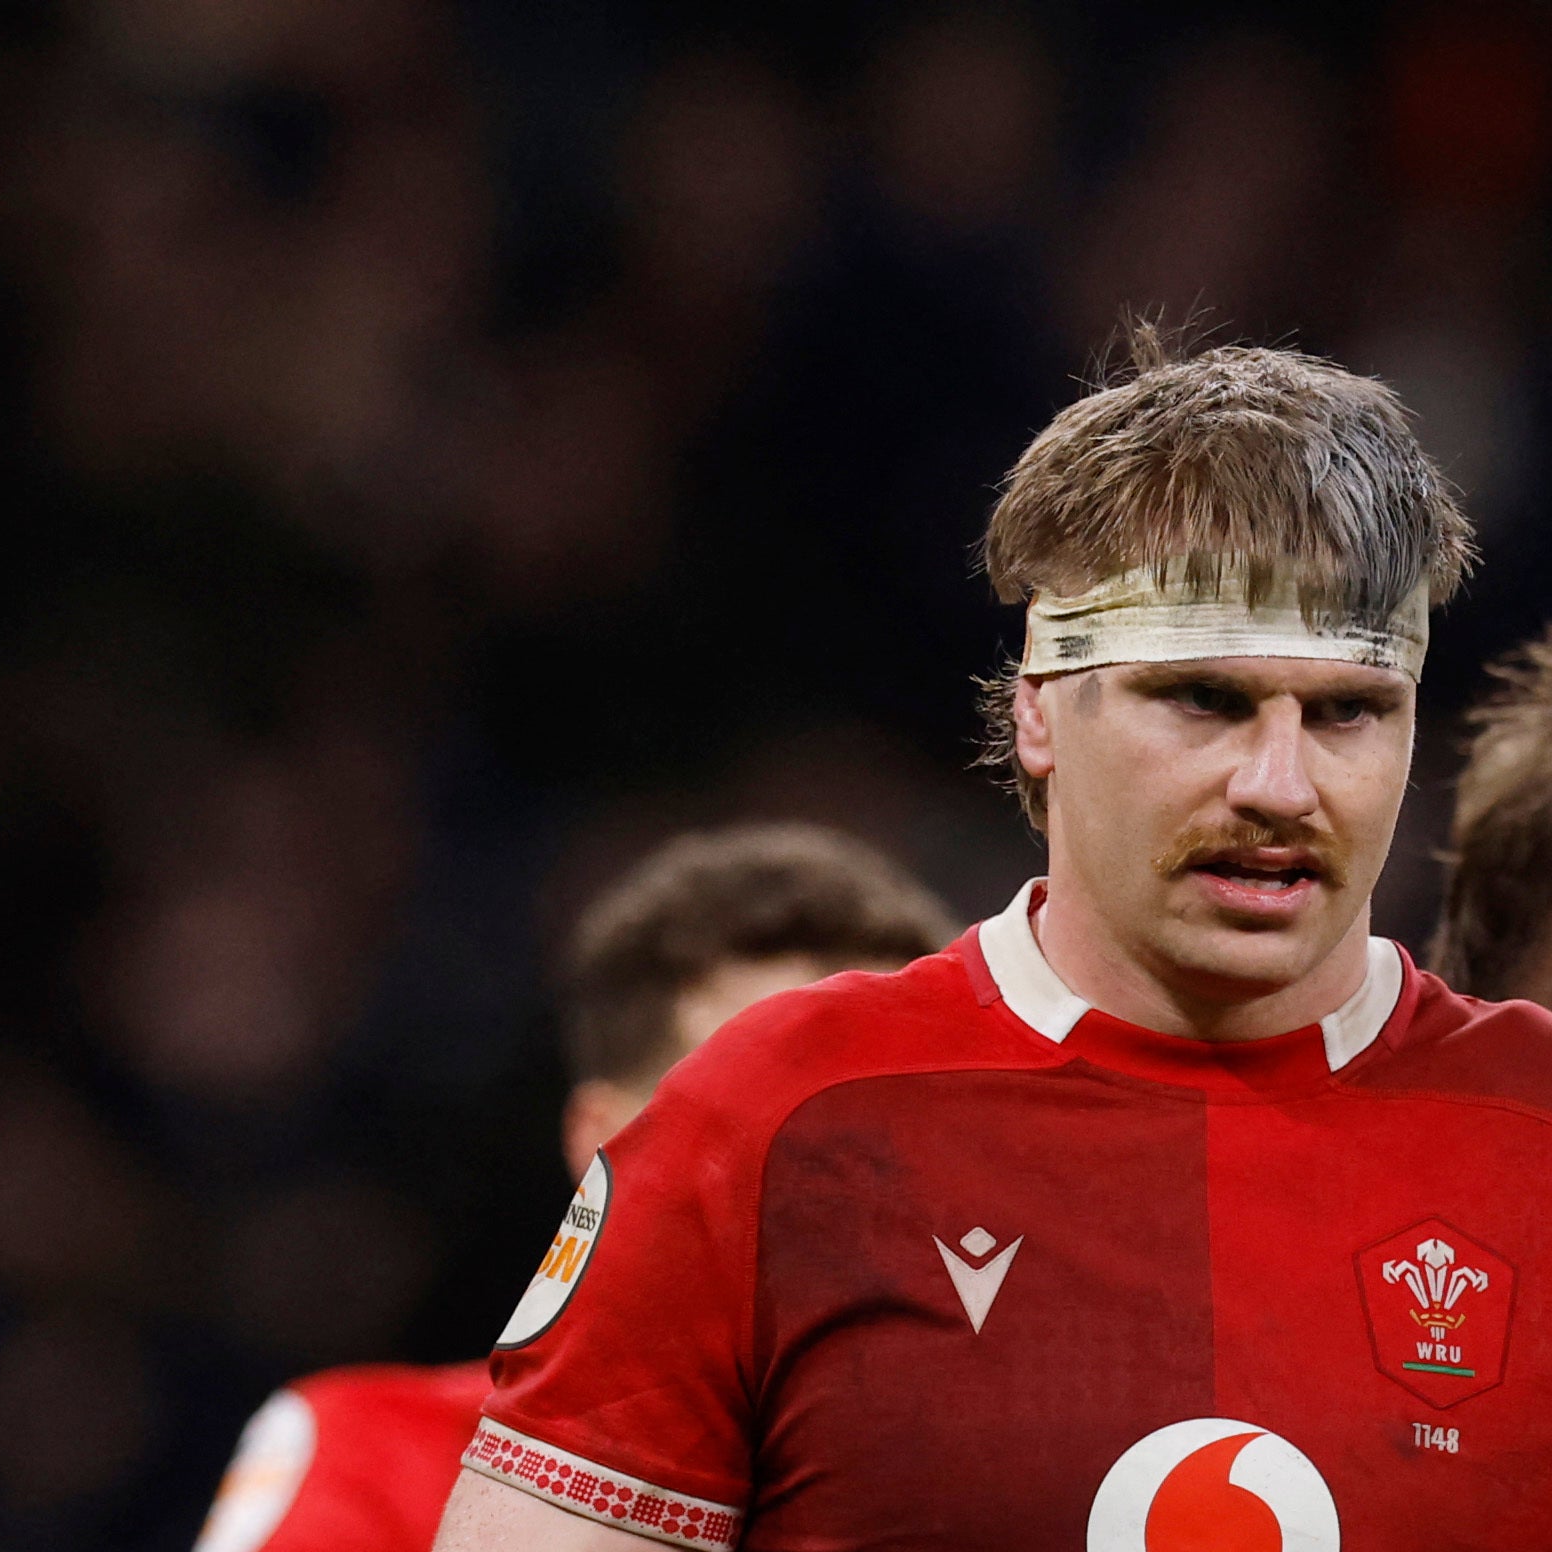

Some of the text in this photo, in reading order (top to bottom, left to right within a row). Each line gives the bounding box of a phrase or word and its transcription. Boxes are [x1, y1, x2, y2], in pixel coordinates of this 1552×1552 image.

[563, 1203, 600, 1233] NESS
[1415, 1341, 1462, 1364] WRU
[1412, 1422, 1460, 1454] 1148
